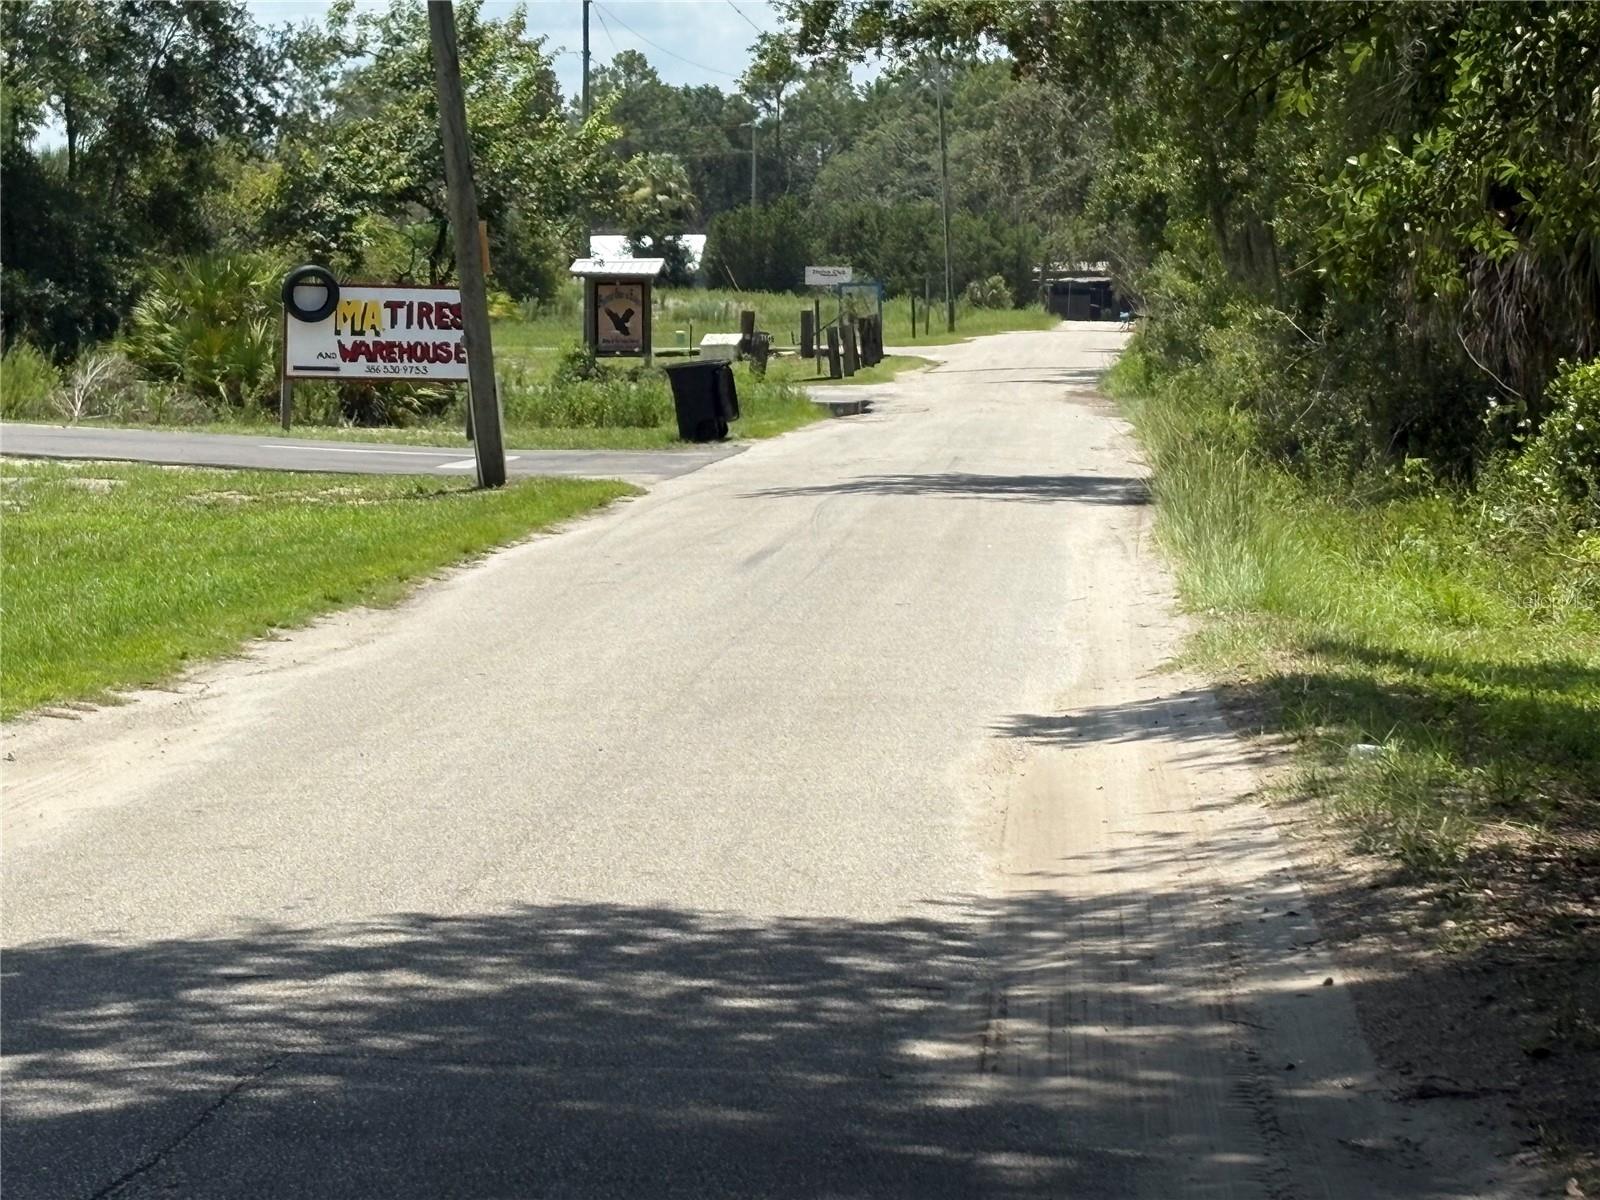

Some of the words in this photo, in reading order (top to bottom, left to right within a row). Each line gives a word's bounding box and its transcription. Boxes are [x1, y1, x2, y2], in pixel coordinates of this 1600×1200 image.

[384, 301, 463, 331] TIRES
[316, 351, 338, 360] AND
[337, 340, 467, 364] WAREHOUSE
